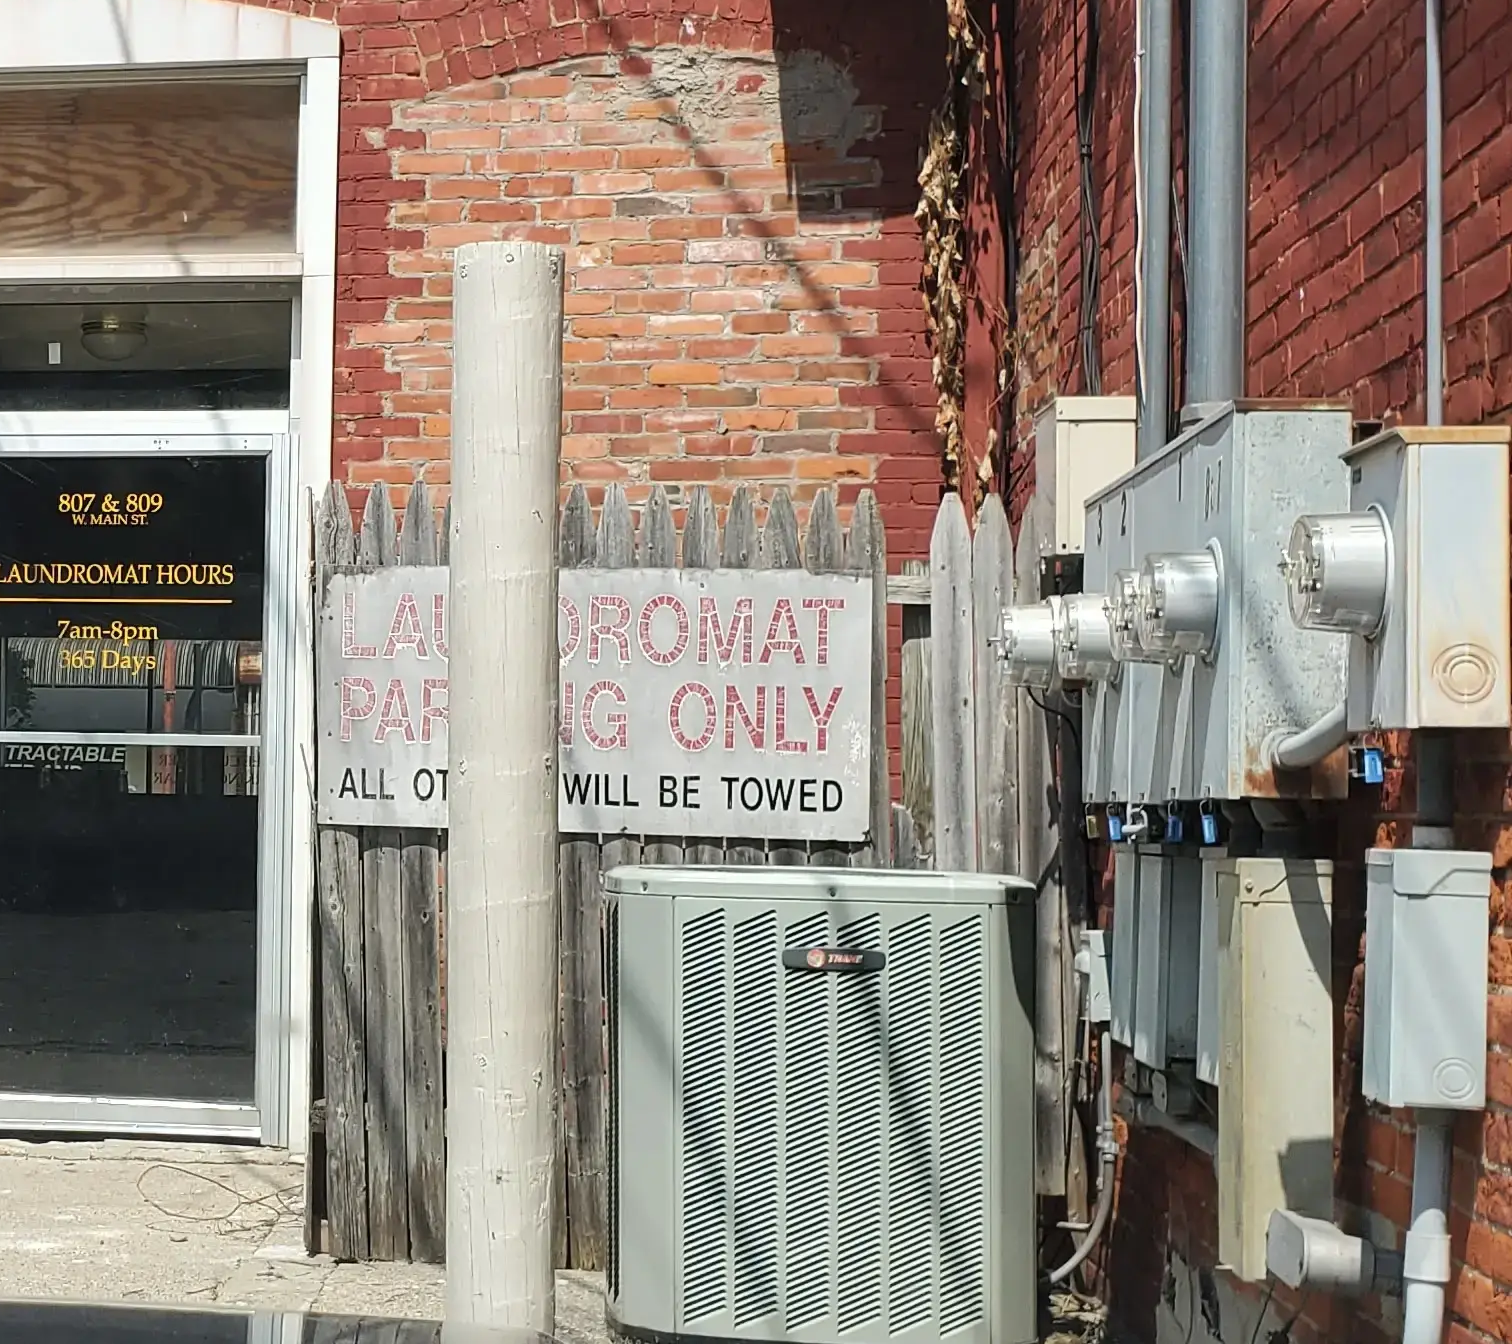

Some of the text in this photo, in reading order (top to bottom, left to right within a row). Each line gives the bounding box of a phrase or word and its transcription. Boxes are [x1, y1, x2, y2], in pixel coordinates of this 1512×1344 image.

[58, 493, 163, 513] 807 & 809
[1120, 491, 1127, 536] 2
[72, 514, 149, 525] W. MAIN ST.
[1096, 504, 1103, 546] 3
[156, 564, 234, 585] HOURS
[57, 620, 158, 645] 7am-8pm
[58, 650, 157, 676] 365 Days
[668, 681, 844, 755] ONLY
[338, 767, 395, 801] ALL
[562, 772, 640, 807] WILL
[658, 774, 701, 809] BE
[720, 776, 844, 813] TOWED
